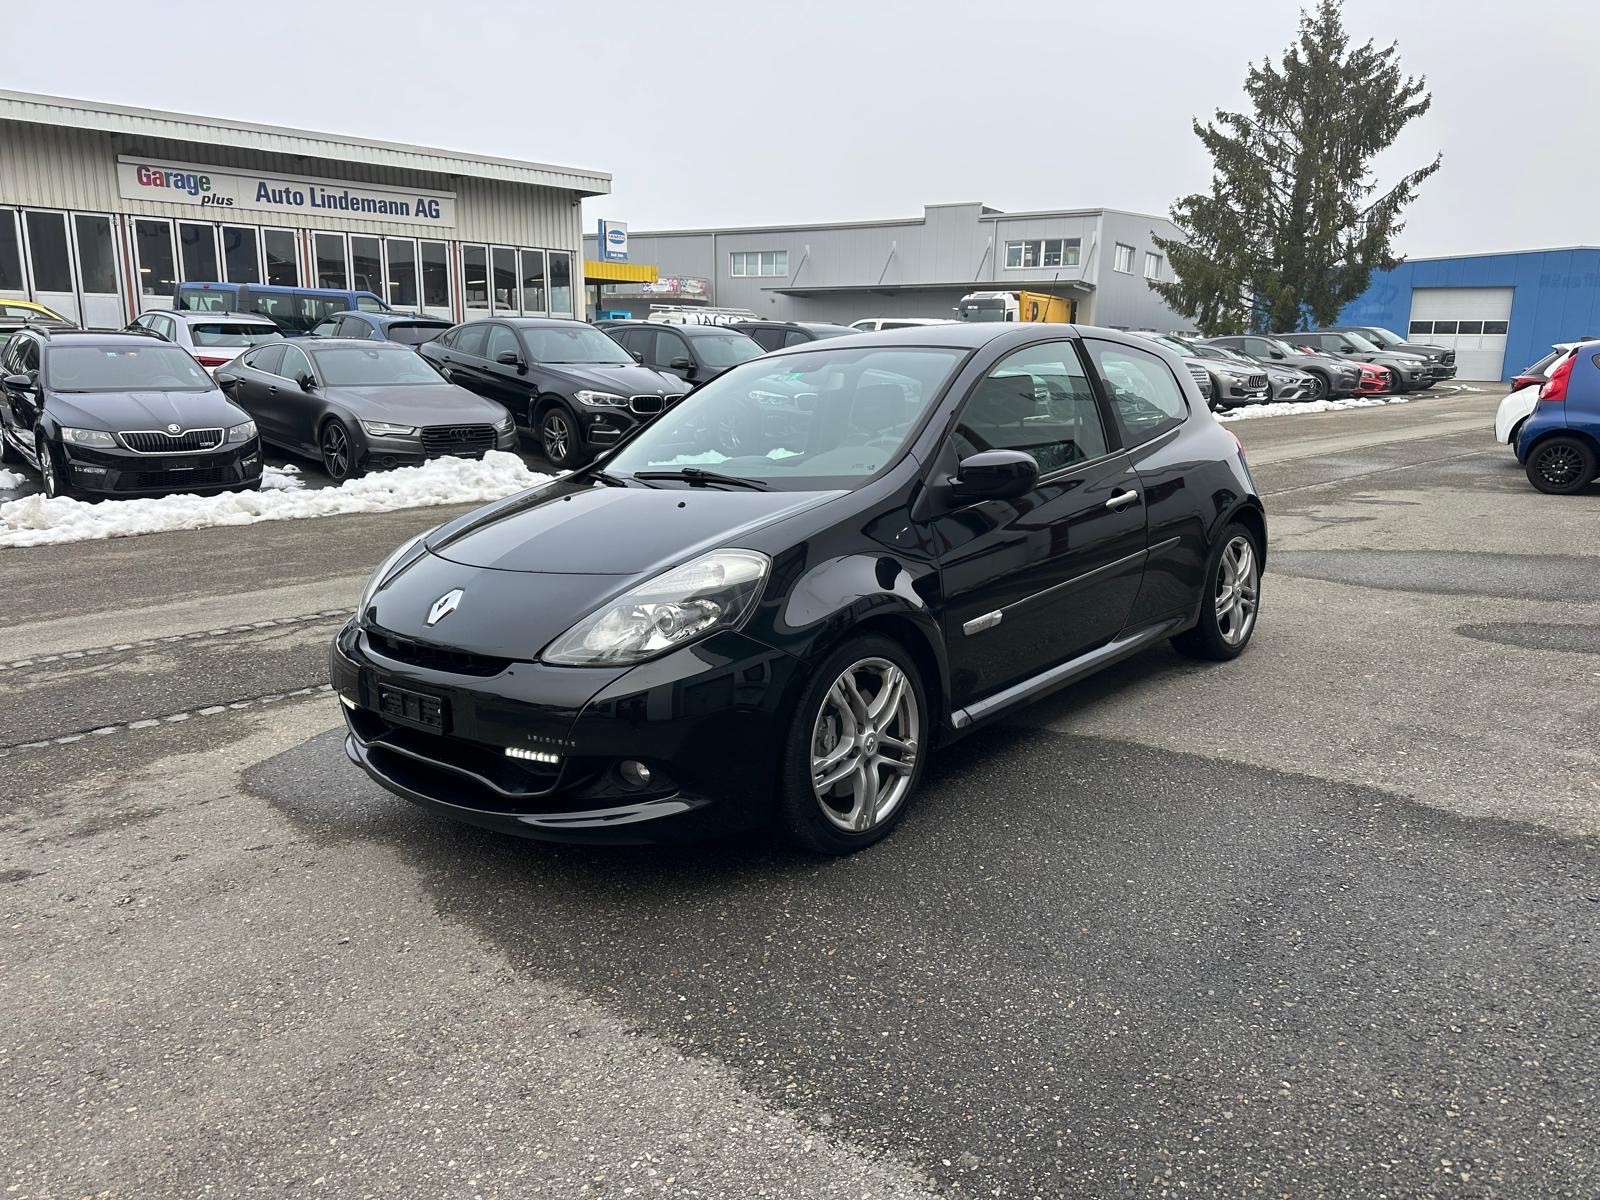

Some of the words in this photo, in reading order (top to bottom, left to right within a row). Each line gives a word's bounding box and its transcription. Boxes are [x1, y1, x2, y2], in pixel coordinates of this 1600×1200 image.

[136, 164, 211, 196] Garage
[201, 193, 234, 207] plus
[255, 181, 304, 206] Auto
[309, 186, 410, 216] Lindemann
[414, 198, 440, 219] AG
